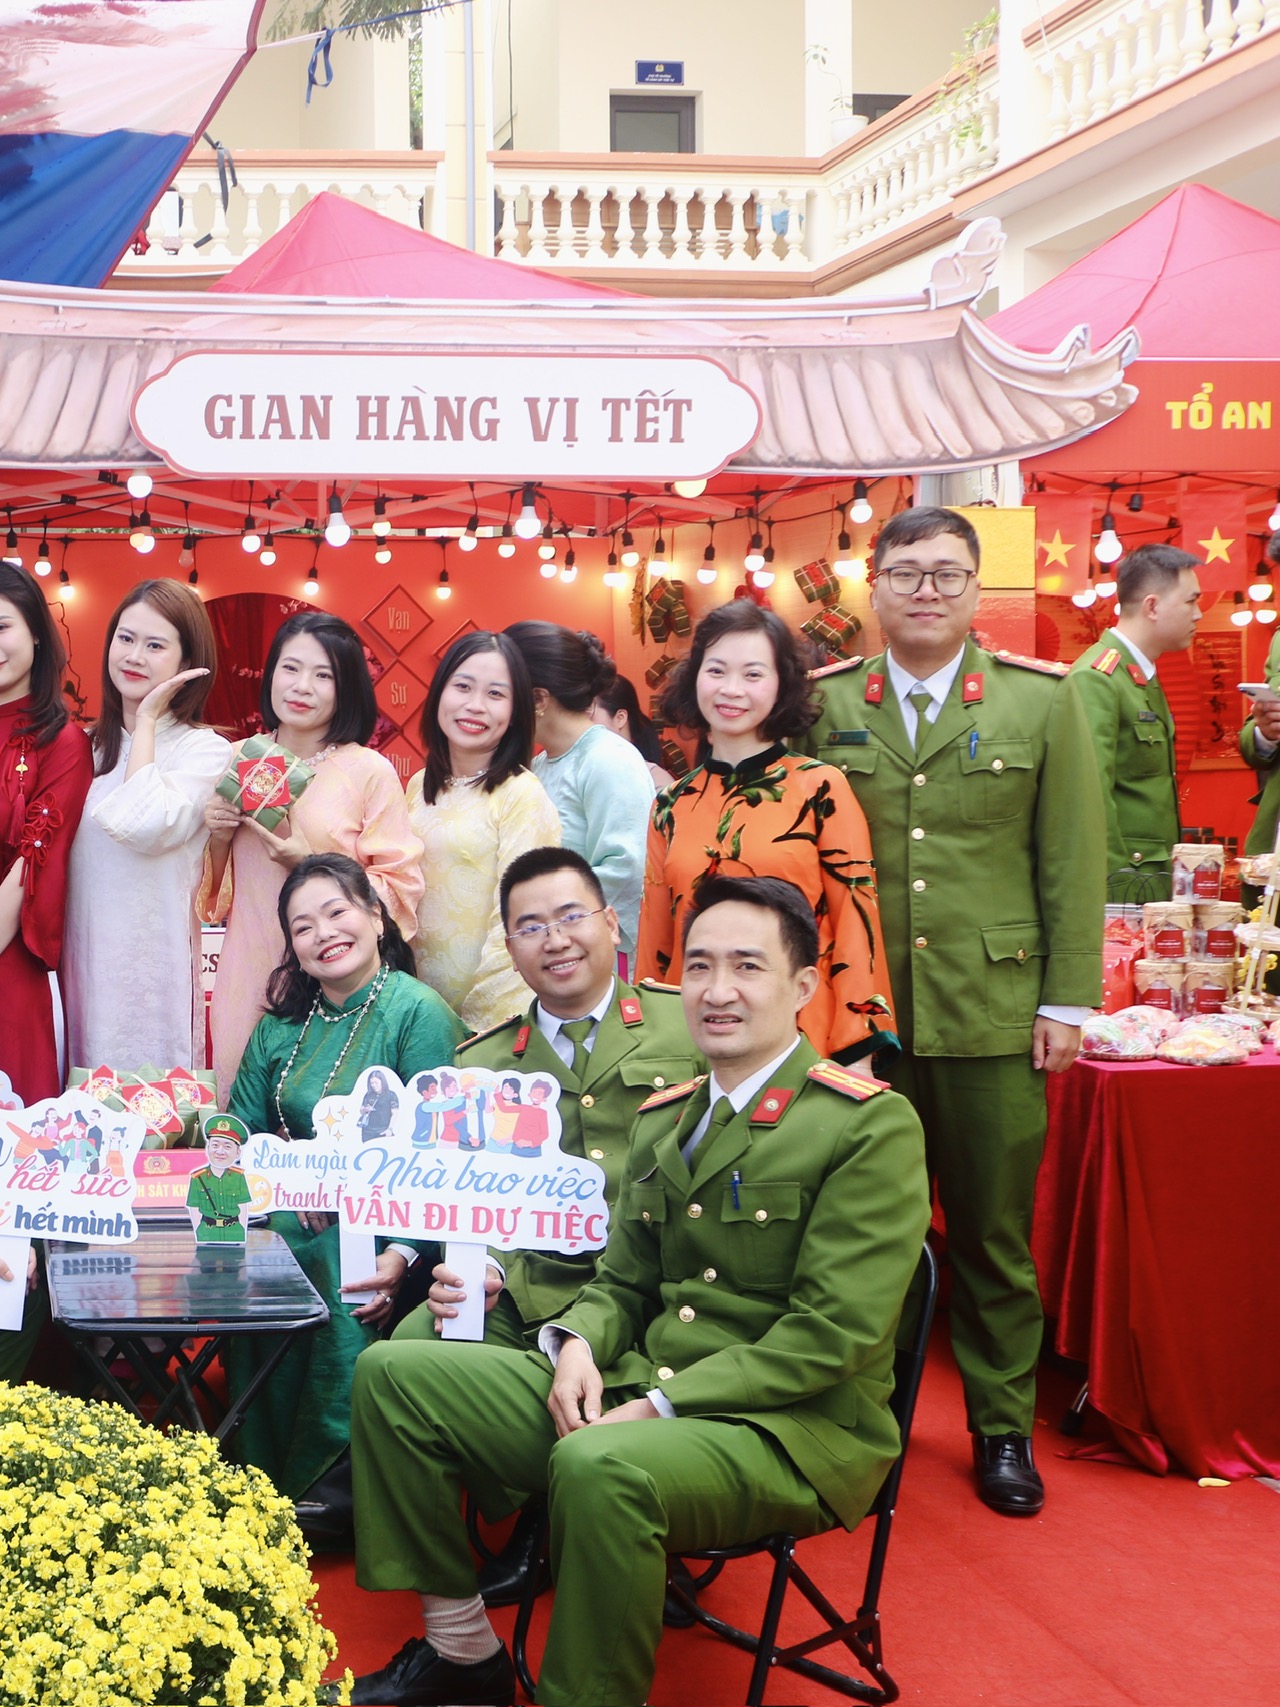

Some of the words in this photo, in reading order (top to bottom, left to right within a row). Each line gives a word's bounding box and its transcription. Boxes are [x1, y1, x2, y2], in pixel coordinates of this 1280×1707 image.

[204, 394, 333, 440] GIAN
[355, 386, 500, 442] HÀNG
[523, 397, 581, 448] VỊ
[601, 388, 693, 443] TẾT
[1165, 382, 1214, 430] TỔ
[1222, 401, 1272, 430] AN
[388, 607, 410, 634] Vạn
[391, 681, 408, 709] Sự
[253, 1139, 302, 1169] Làm
[6, 1155, 60, 1192] hết
[70, 1168, 132, 1198] sức
[148, 1182, 169, 1198] SÁT
[353, 1147, 450, 1196] Nhà
[454, 1155, 524, 1195] bao
[525, 1165, 598, 1207] việc
[273, 1182, 332, 1209] tranh
[14, 1202, 60, 1232] hết
[62, 1209, 132, 1239] mình
[343, 1184, 411, 1228] VẪN
[423, 1202, 458, 1232] ĐI
[471, 1206, 522, 1244] DỰ
[530, 1205, 604, 1248] TIỆC
